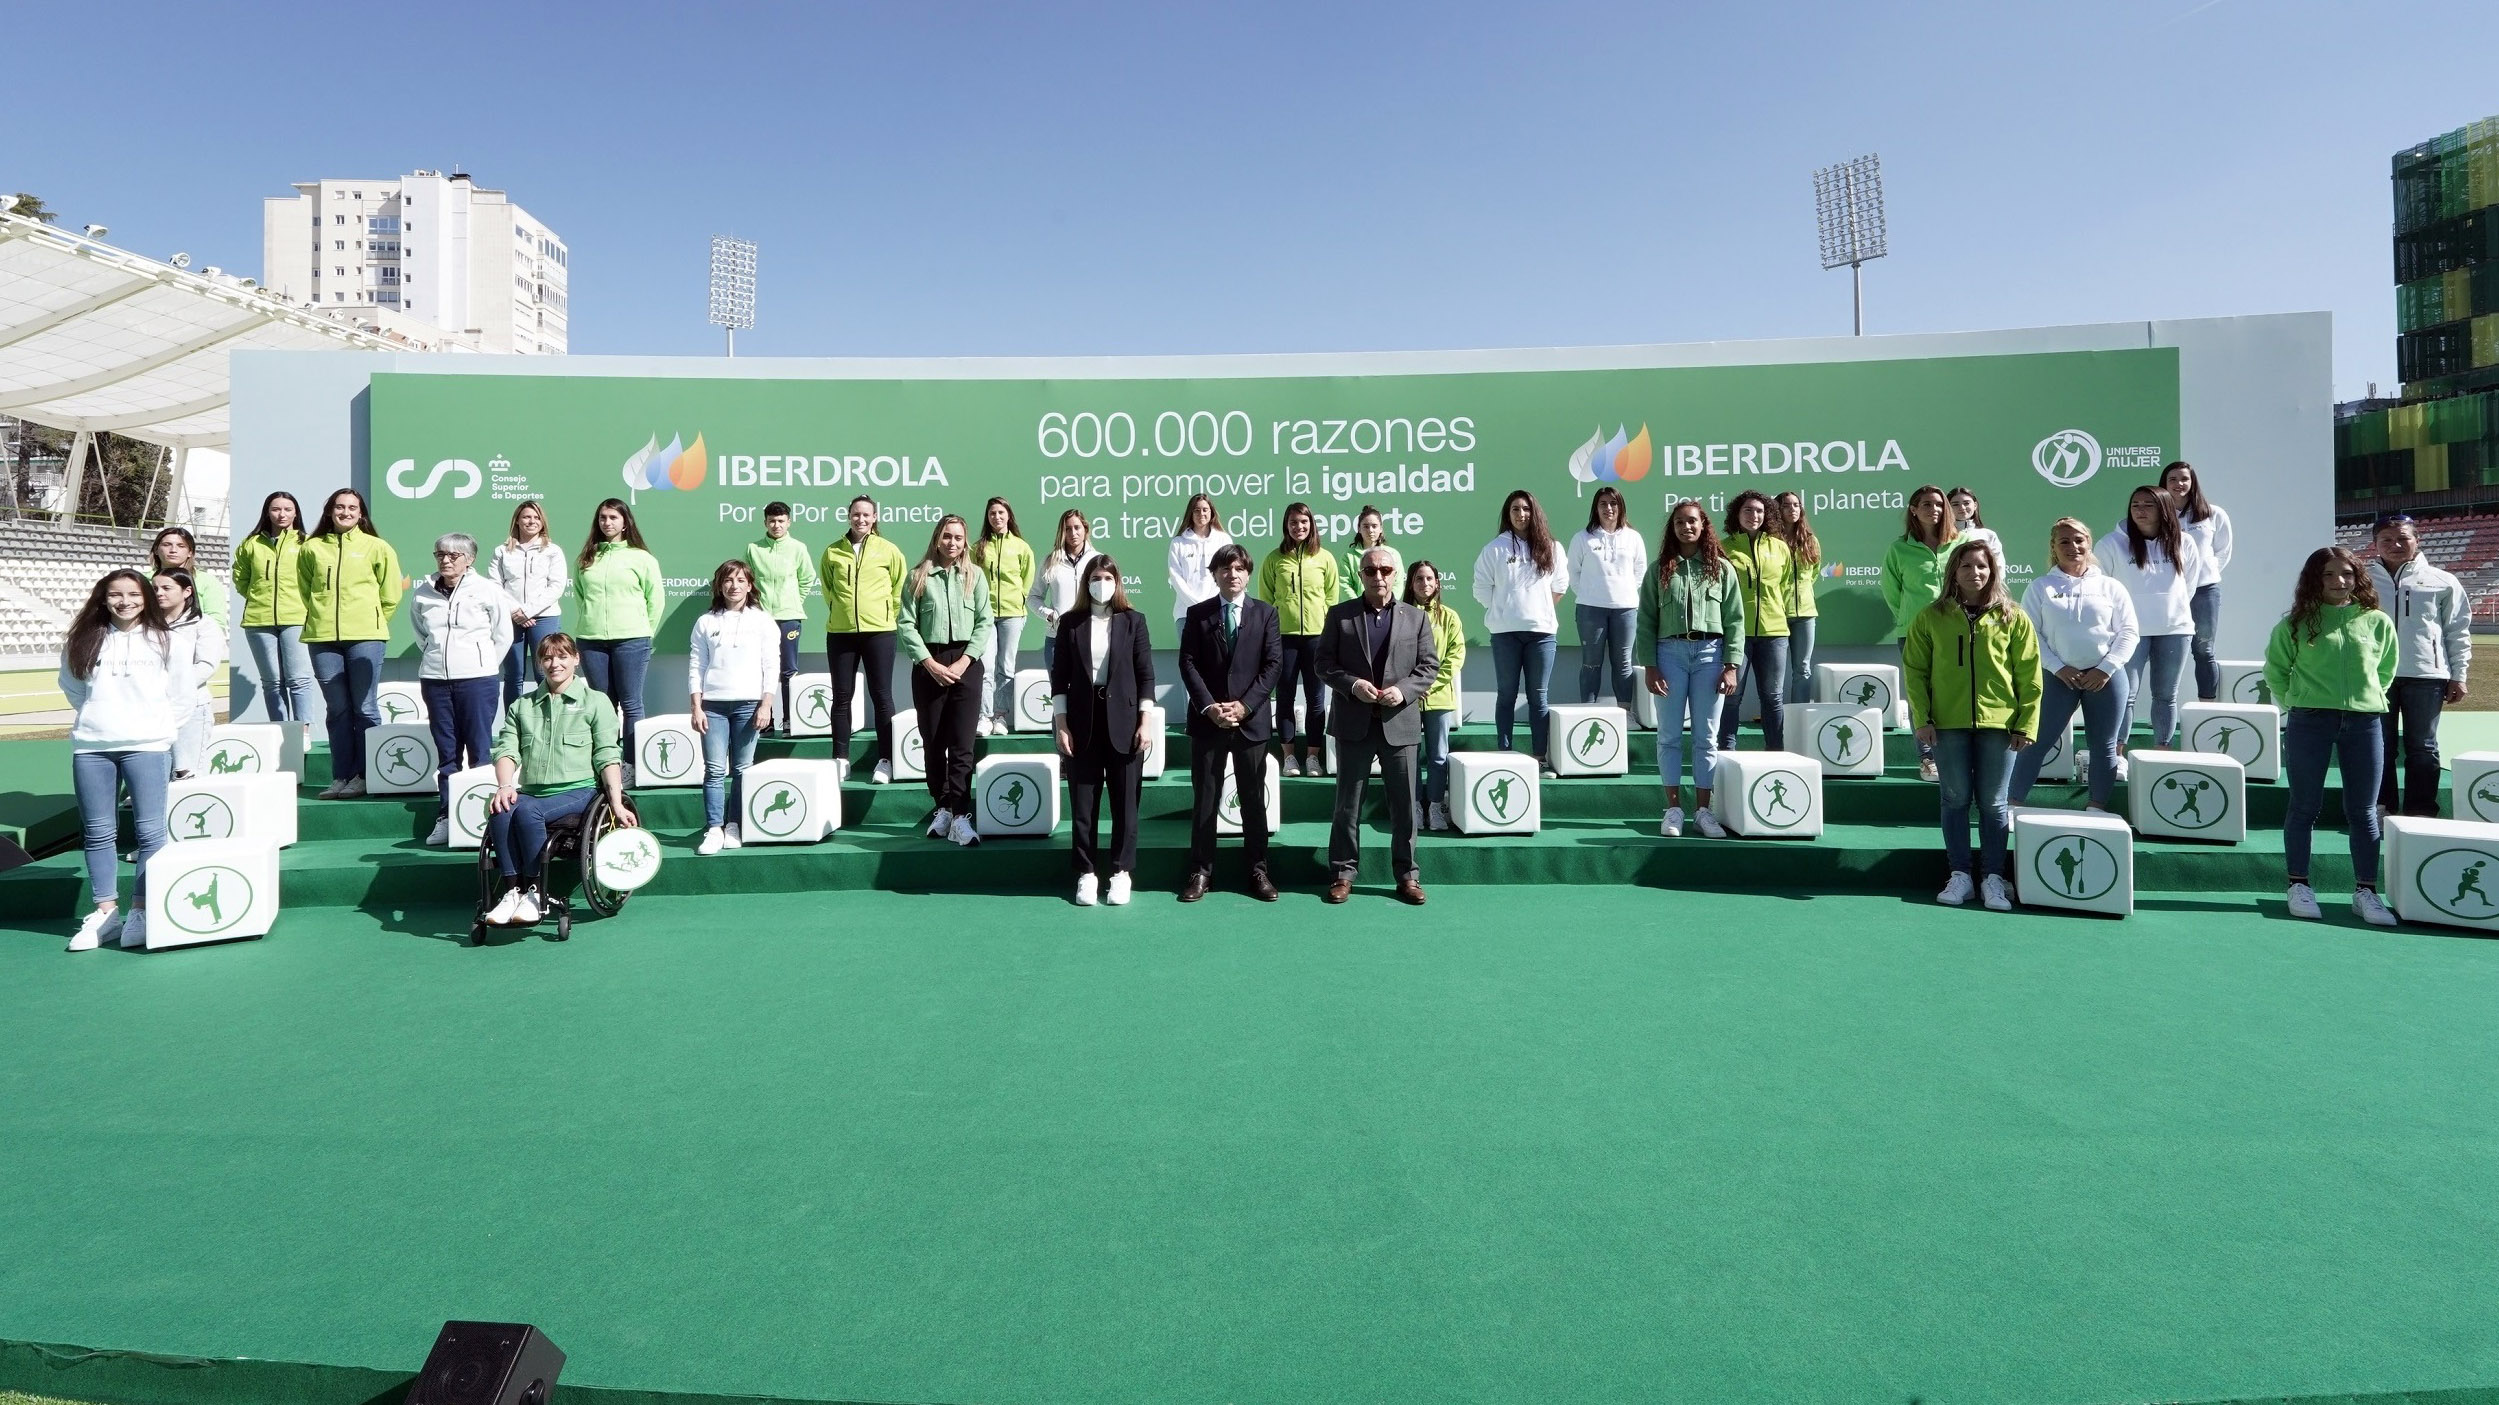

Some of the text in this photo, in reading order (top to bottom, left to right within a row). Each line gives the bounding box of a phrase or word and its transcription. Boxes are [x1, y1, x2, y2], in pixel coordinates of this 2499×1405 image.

[1037, 410, 1476, 458] 600.000 razones
[1664, 439, 1910, 476] IBERDROLA
[2106, 446, 2161, 456] UNIVERSO
[2106, 455, 2161, 468] MUJER
[718, 455, 949, 487] IBERDROLA
[491, 474, 527, 486] Consejo
[1040, 462, 1475, 504] para promover la igualdad
[491, 482, 529, 493] Superior
[491, 491, 544, 501] de Deportes
[719, 501, 943, 523] Por Por e laneta
[1091, 516, 1111, 539] a
[1120, 511, 1182, 539] trav
[1228, 508, 1274, 538] del
[1845, 566, 1882, 576] IBERD
[661, 577, 711, 587] ERDROLA
